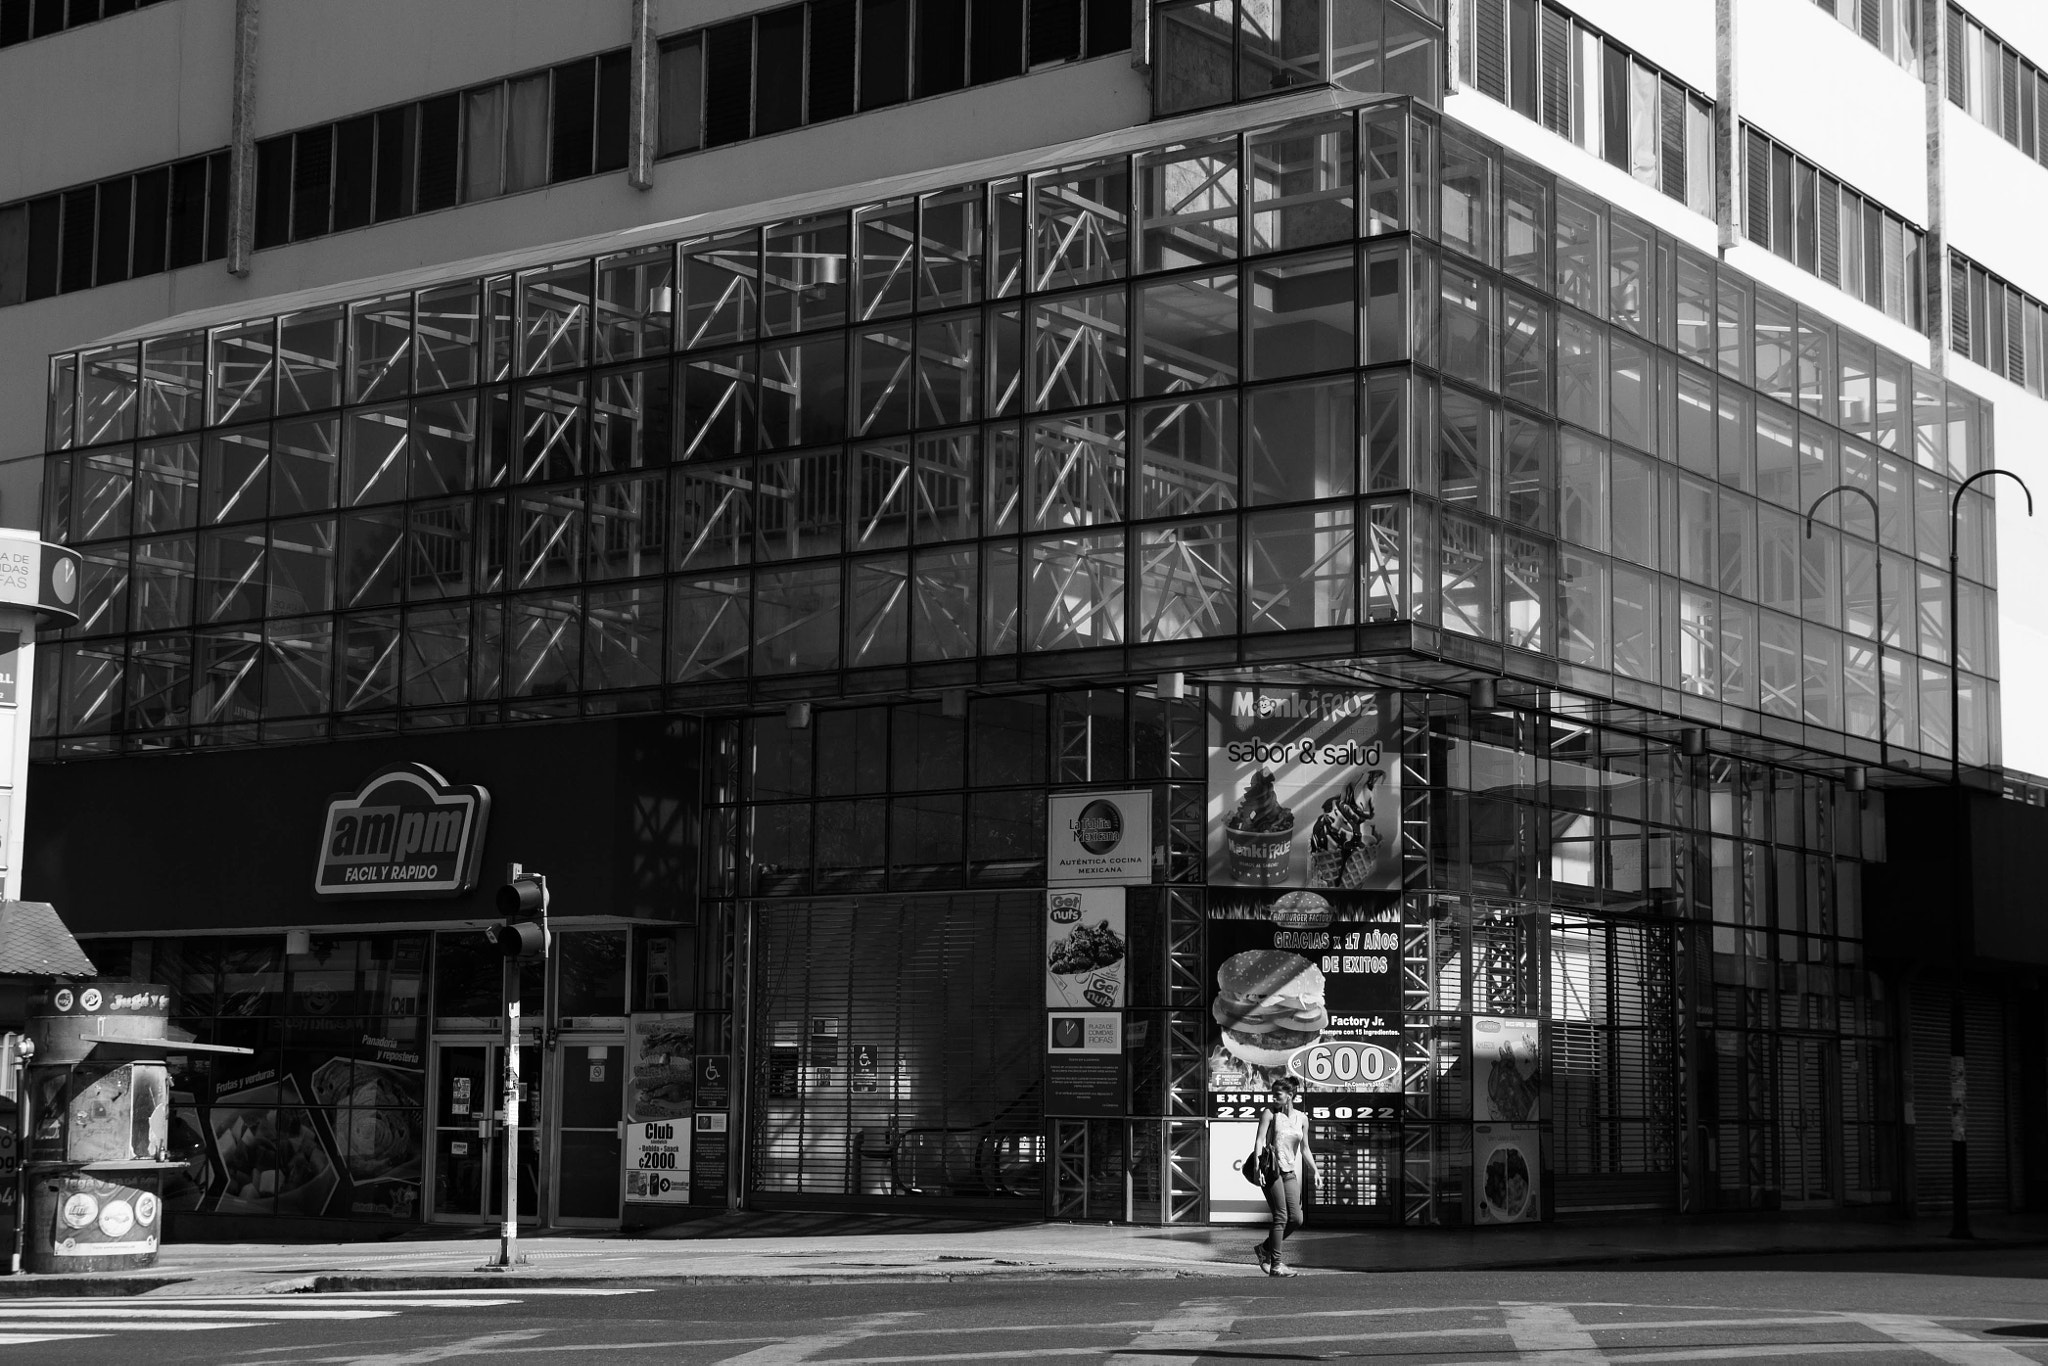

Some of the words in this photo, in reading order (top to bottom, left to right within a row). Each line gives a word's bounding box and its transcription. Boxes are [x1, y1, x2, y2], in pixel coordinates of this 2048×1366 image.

[14, 554, 30, 564] DE
[1228, 737, 1293, 763] sabor
[1299, 740, 1318, 765] &
[1323, 742, 1381, 766] salud
[1069, 819, 1080, 830] La
[331, 810, 463, 862] ampm
[1073, 830, 1120, 842] Mexicana
[345, 866, 377, 881] FACIL
[381, 866, 389, 880] Y
[391, 864, 438, 880] RAPIDO
[1052, 895, 1079, 908] Get
[1053, 909, 1079, 920] nuts
[1273, 912, 1308, 922] HAMBURGER
[1309, 912, 1332, 922] FACTORY
[1274, 931, 1330, 949] GRACIAS
[1345, 932, 1360, 950] 17
[1364, 929, 1399, 950] AÑOS
[1322, 956, 1339, 973] DE
[1343, 956, 1388, 973] EXITOS
[1092, 978, 1119, 995] Get
[1086, 991, 1112, 1008] nuts
[1331, 1015, 1370, 1028] Factory
[1371, 1015, 1385, 1026] Jr.
[1319, 1028, 1342, 1036] Siempre
[1088, 1036, 1114, 1044] ROFAS
[376, 1049, 383, 1060] y
[1308, 1047, 1384, 1081] 600
[216, 1079, 238, 1093] Frutas
[239, 1078, 244, 1088] y
[245, 1069, 276, 1085] verduras
[1216, 1094, 1303, 1103] EXPRES
[645, 1122, 674, 1140] Club
